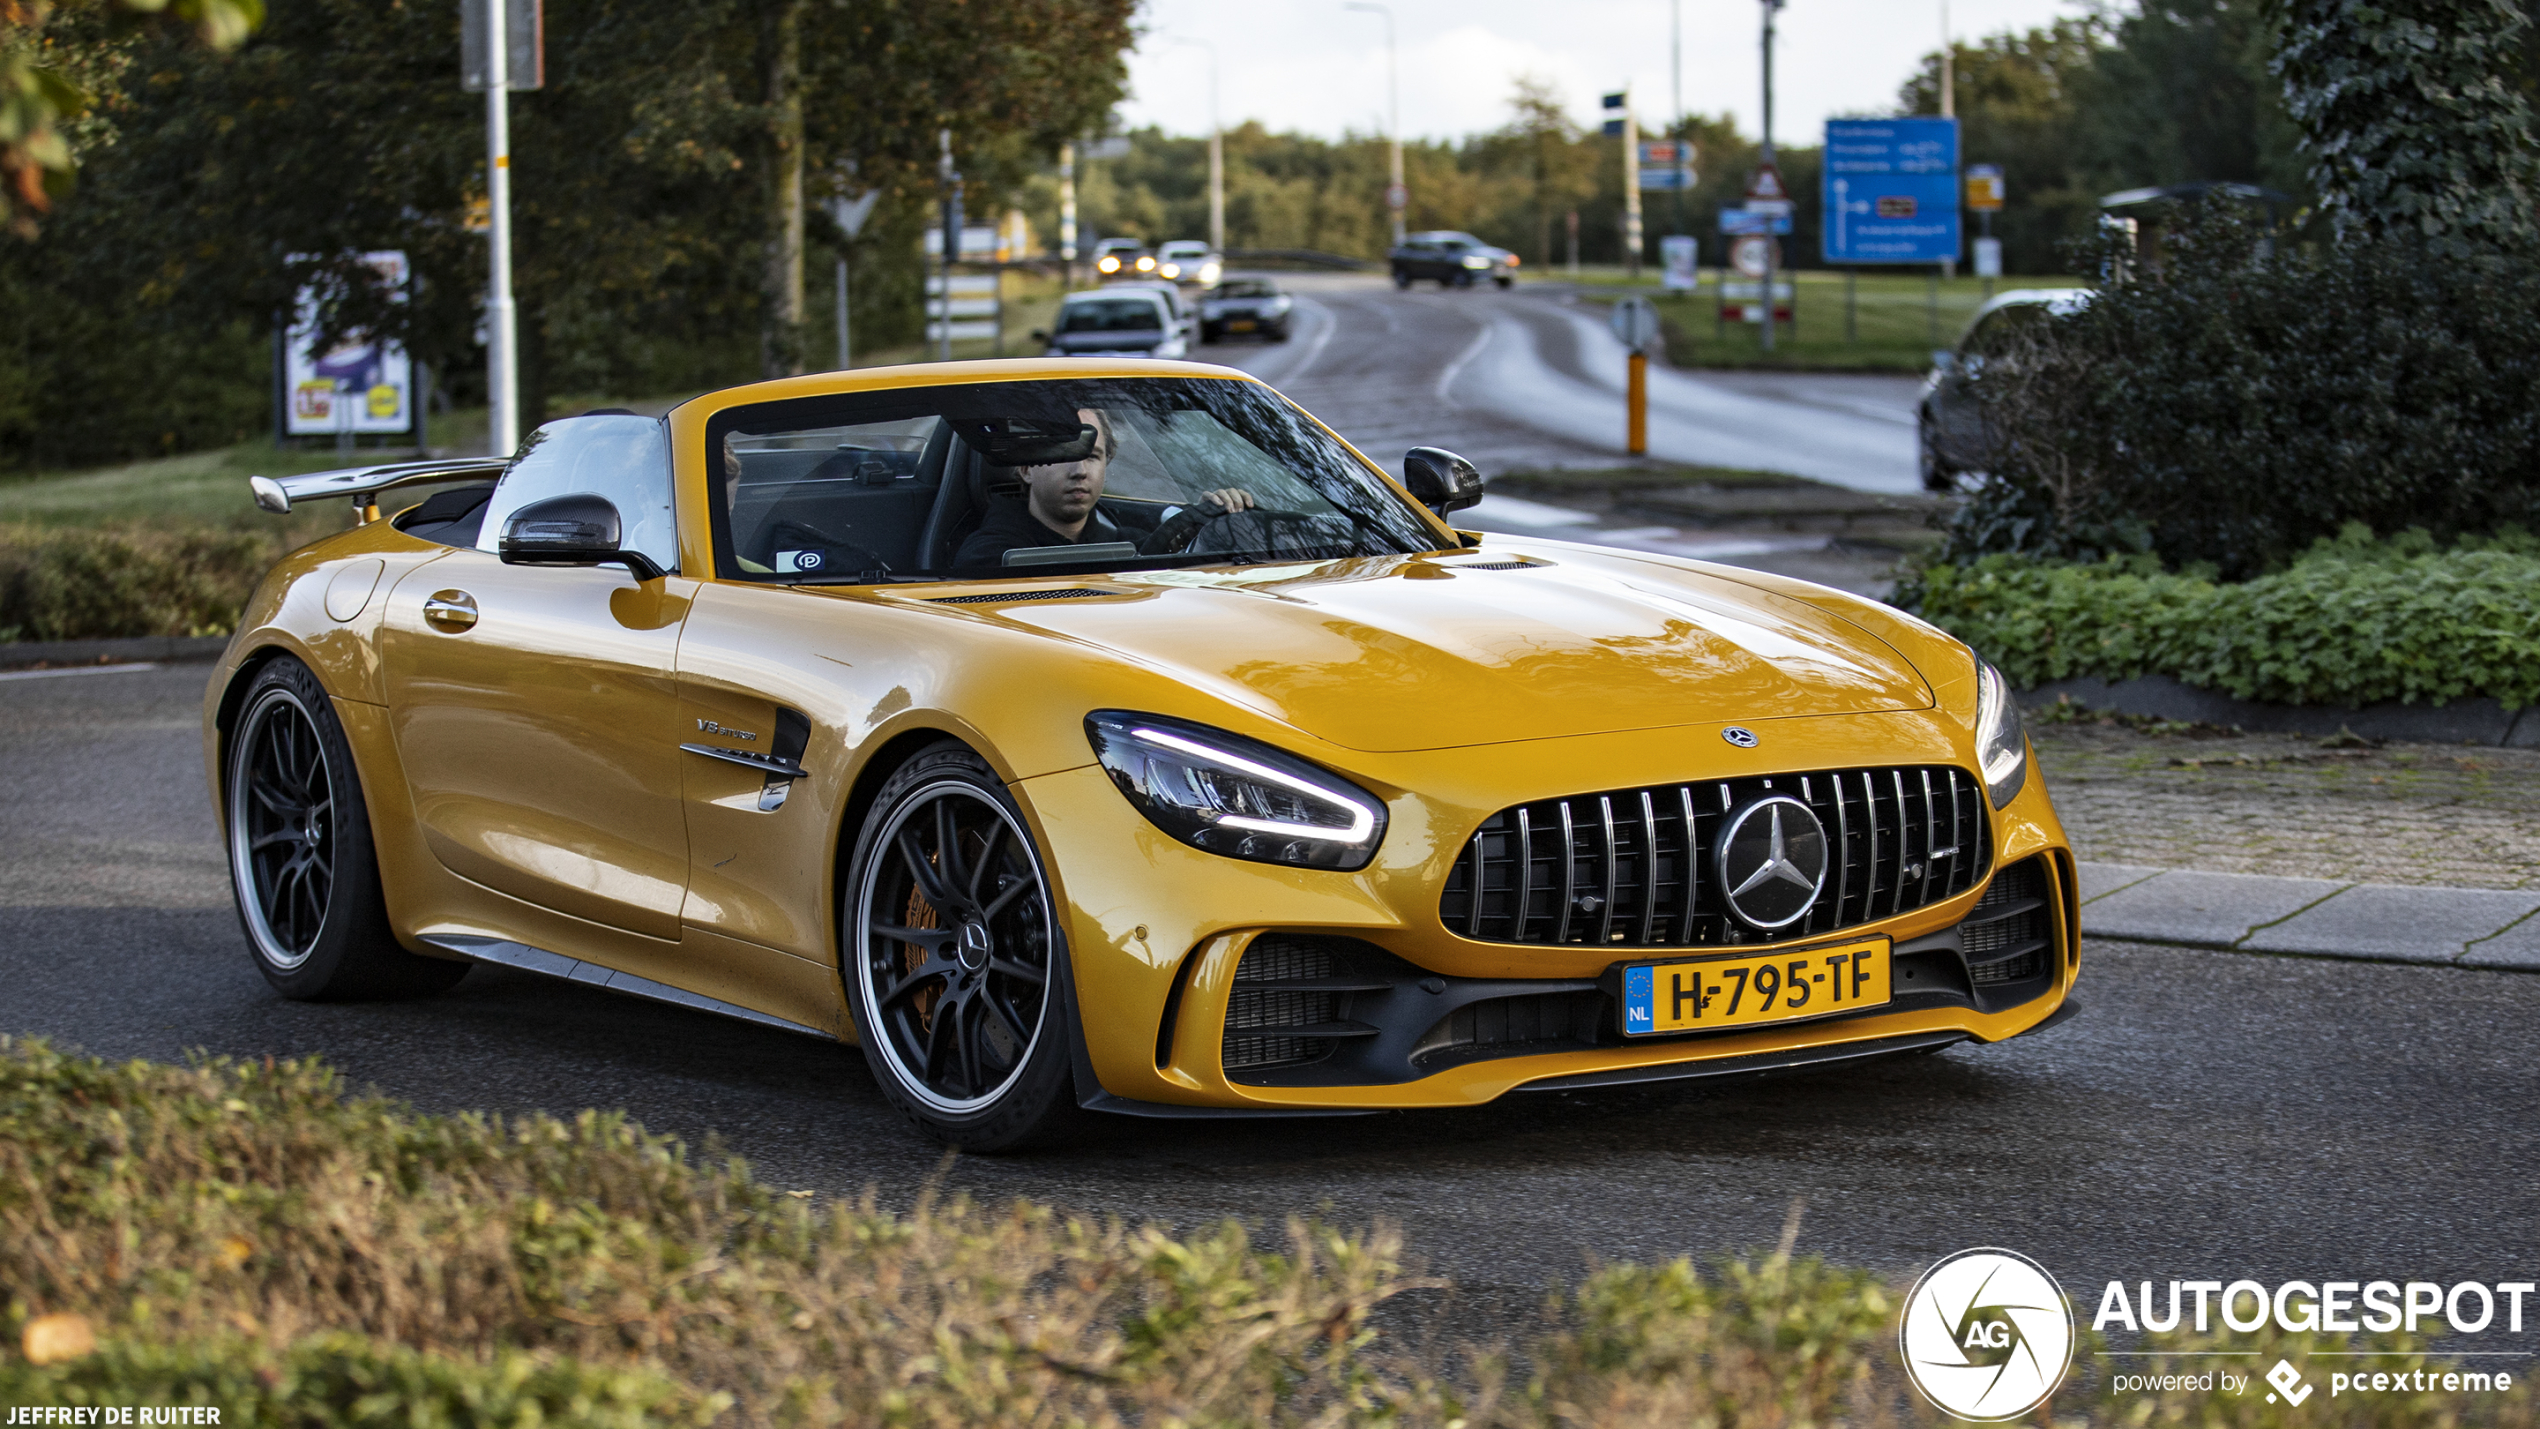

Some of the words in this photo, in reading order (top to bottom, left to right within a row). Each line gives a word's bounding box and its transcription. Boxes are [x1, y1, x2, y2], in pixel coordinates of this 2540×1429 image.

[697, 718, 718, 734] V8
[719, 726, 757, 741] BITURBO
[1672, 950, 1872, 1020] H-795-TF
[1629, 1006, 1650, 1021] NL
